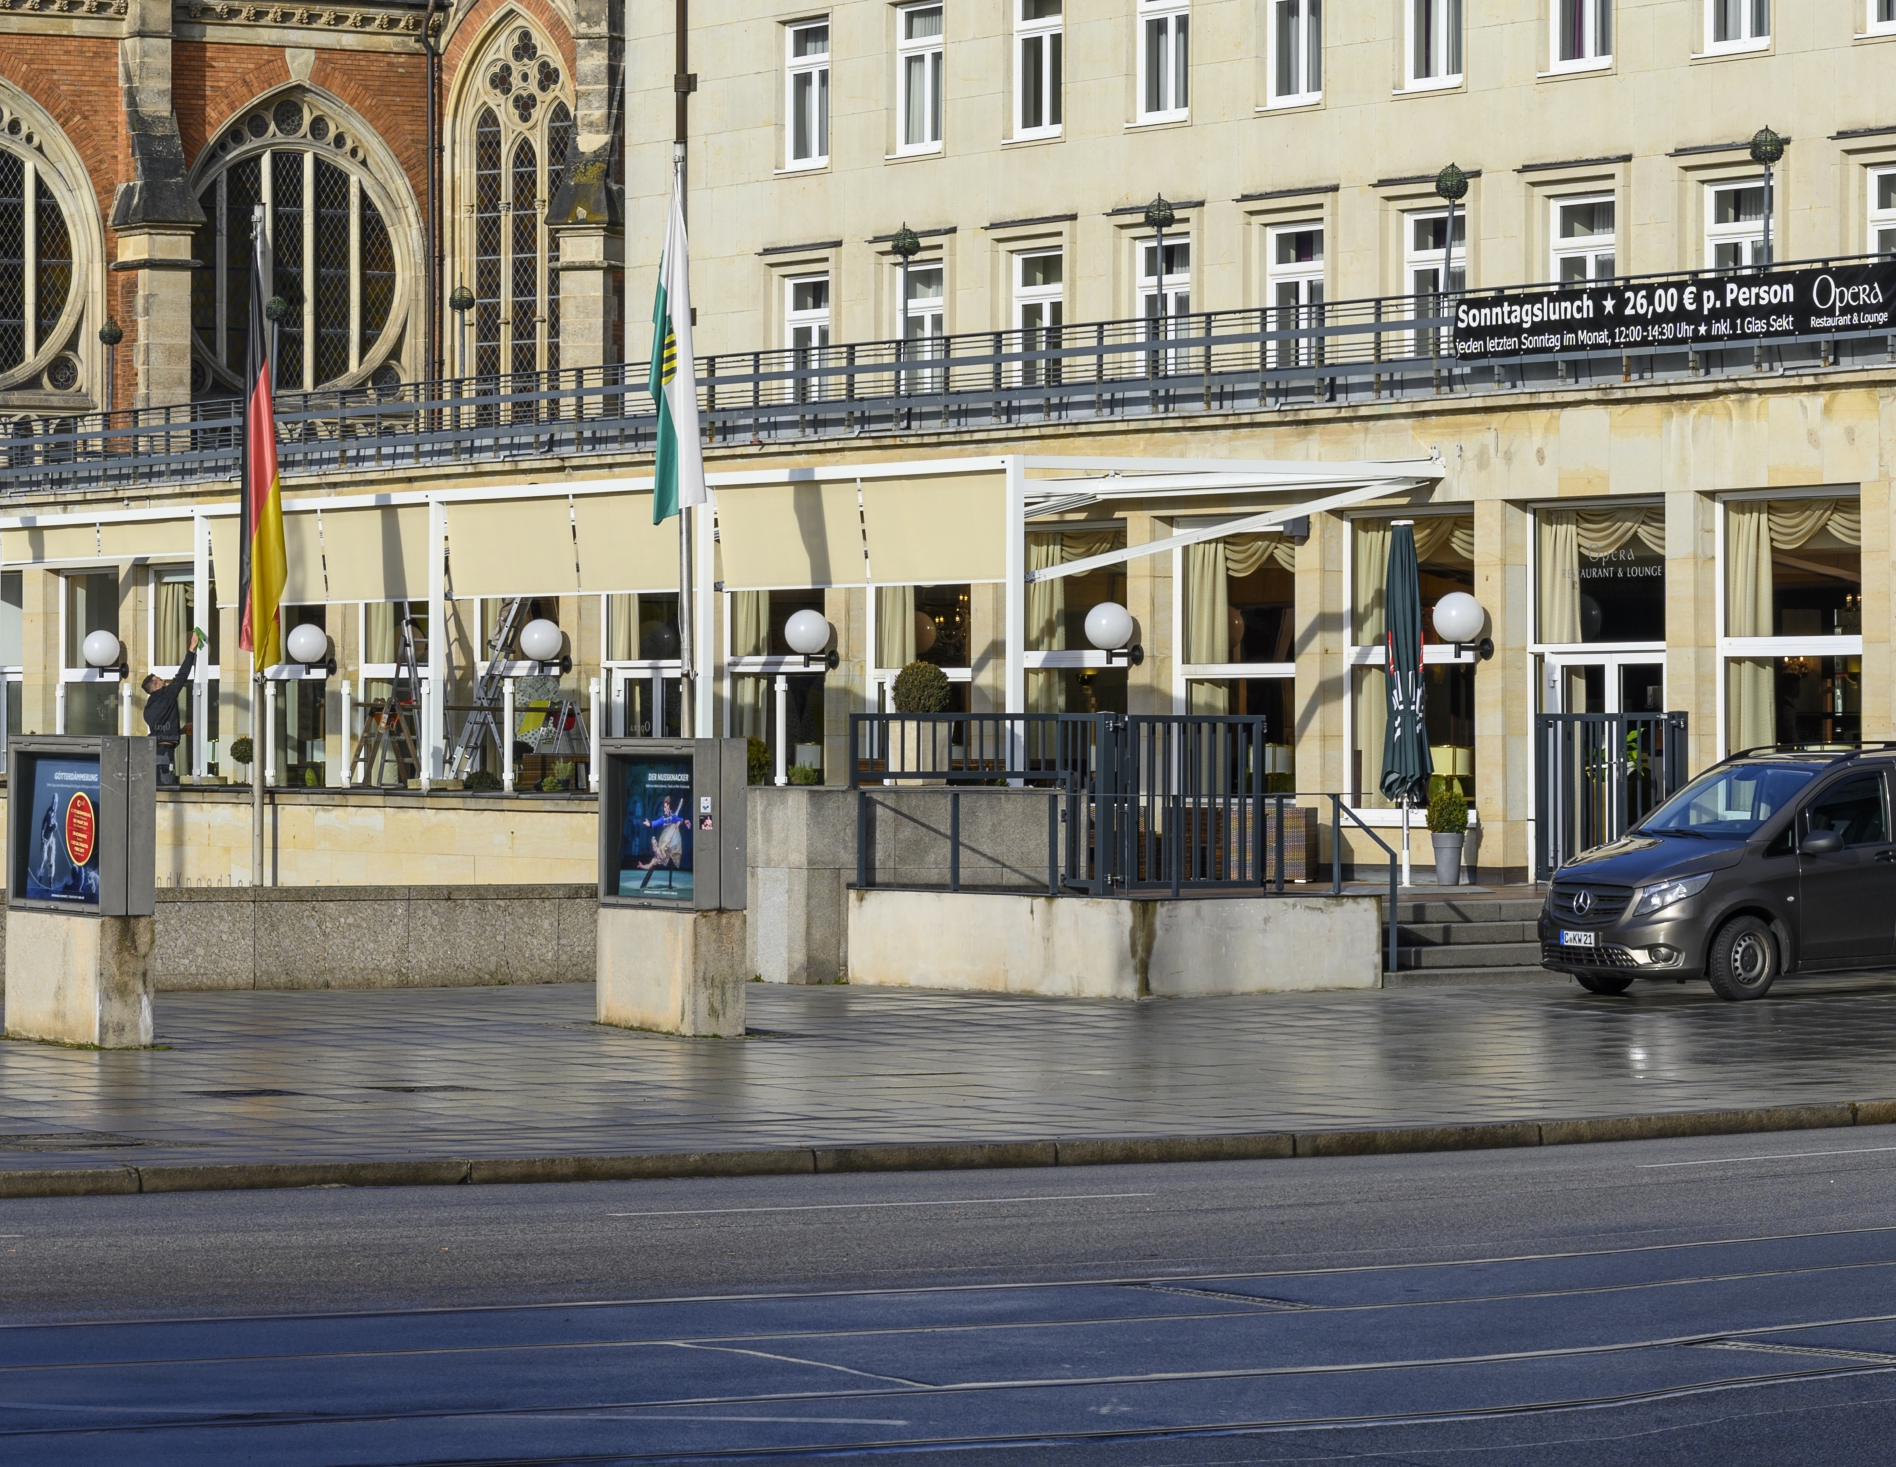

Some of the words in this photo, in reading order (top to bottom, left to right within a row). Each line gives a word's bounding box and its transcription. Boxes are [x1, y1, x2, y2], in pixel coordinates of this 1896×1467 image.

[1812, 274, 1883, 315] Opera
[1457, 295, 1594, 329] Sonntagslunch
[1624, 286, 1678, 319] 26,00
[1682, 285, 1697, 311] €
[1703, 289, 1721, 314] p.
[1725, 282, 1794, 308] Person
[1810, 313, 1852, 328] Restaurant
[1852, 312, 1860, 324] &
[1860, 311, 1889, 327] Lounge
[1455, 336, 1484, 357] jeden
[1486, 334, 1519, 352] letzten
[1521, 331, 1561, 354] Sonntag
[1563, 331, 1576, 347] im
[1578, 329, 1612, 348] Monat,
[1614, 326, 1675, 343] 12:00-14:30
[1676, 323, 1695, 339] Uhr
[1711, 320, 1733, 336] inkl.
[1736, 320, 1743, 335] 1
[1744, 318, 1767, 334] Glas
[1769, 314, 1794, 332] Sekt
[1589, 543, 1635, 566] Opera
[1561, 567, 1614, 579] RESTAURANT
[1617, 567, 1624, 578] &
[1627, 565, 1662, 578] LOUNGE
[657, 773, 689, 782] NUSSKNACKER
[1572, 933, 1583, 944] KW
[1583, 934, 1593, 945] 21
